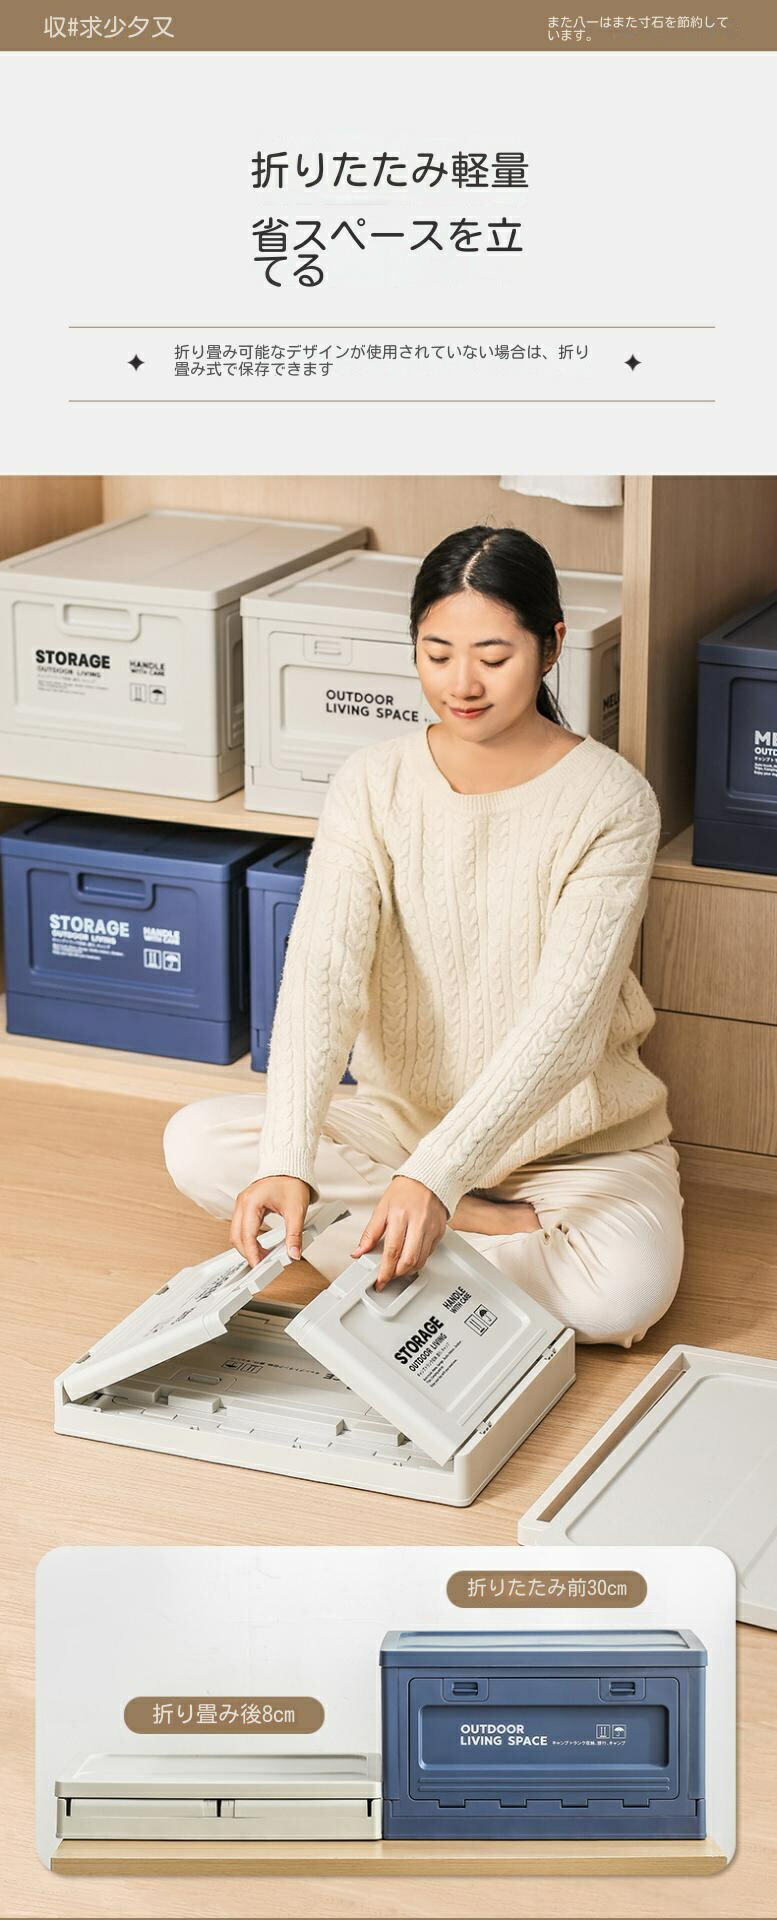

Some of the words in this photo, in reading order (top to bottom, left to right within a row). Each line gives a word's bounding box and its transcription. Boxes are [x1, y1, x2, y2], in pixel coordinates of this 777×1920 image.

[35, 649, 111, 669] STORAGE
[326, 689, 394, 706] OUTDOOR
[326, 702, 370, 717] LIVING
[376, 707, 419, 722] SPACE
[49, 913, 130, 938] STORAGE
[442, 1286, 466, 1310] HANDLE
[449, 1300, 463, 1314] WITH
[459, 1291, 472, 1306] CARE
[393, 1315, 445, 1365] STORAGE
[408, 1346, 434, 1372] OUTDOOR
[430, 1332, 448, 1351] LIVING
[460, 1724, 525, 1735] OUTDOOR
[460, 1735, 502, 1746] LIVING
[507, 1735, 548, 1746] SPACE
